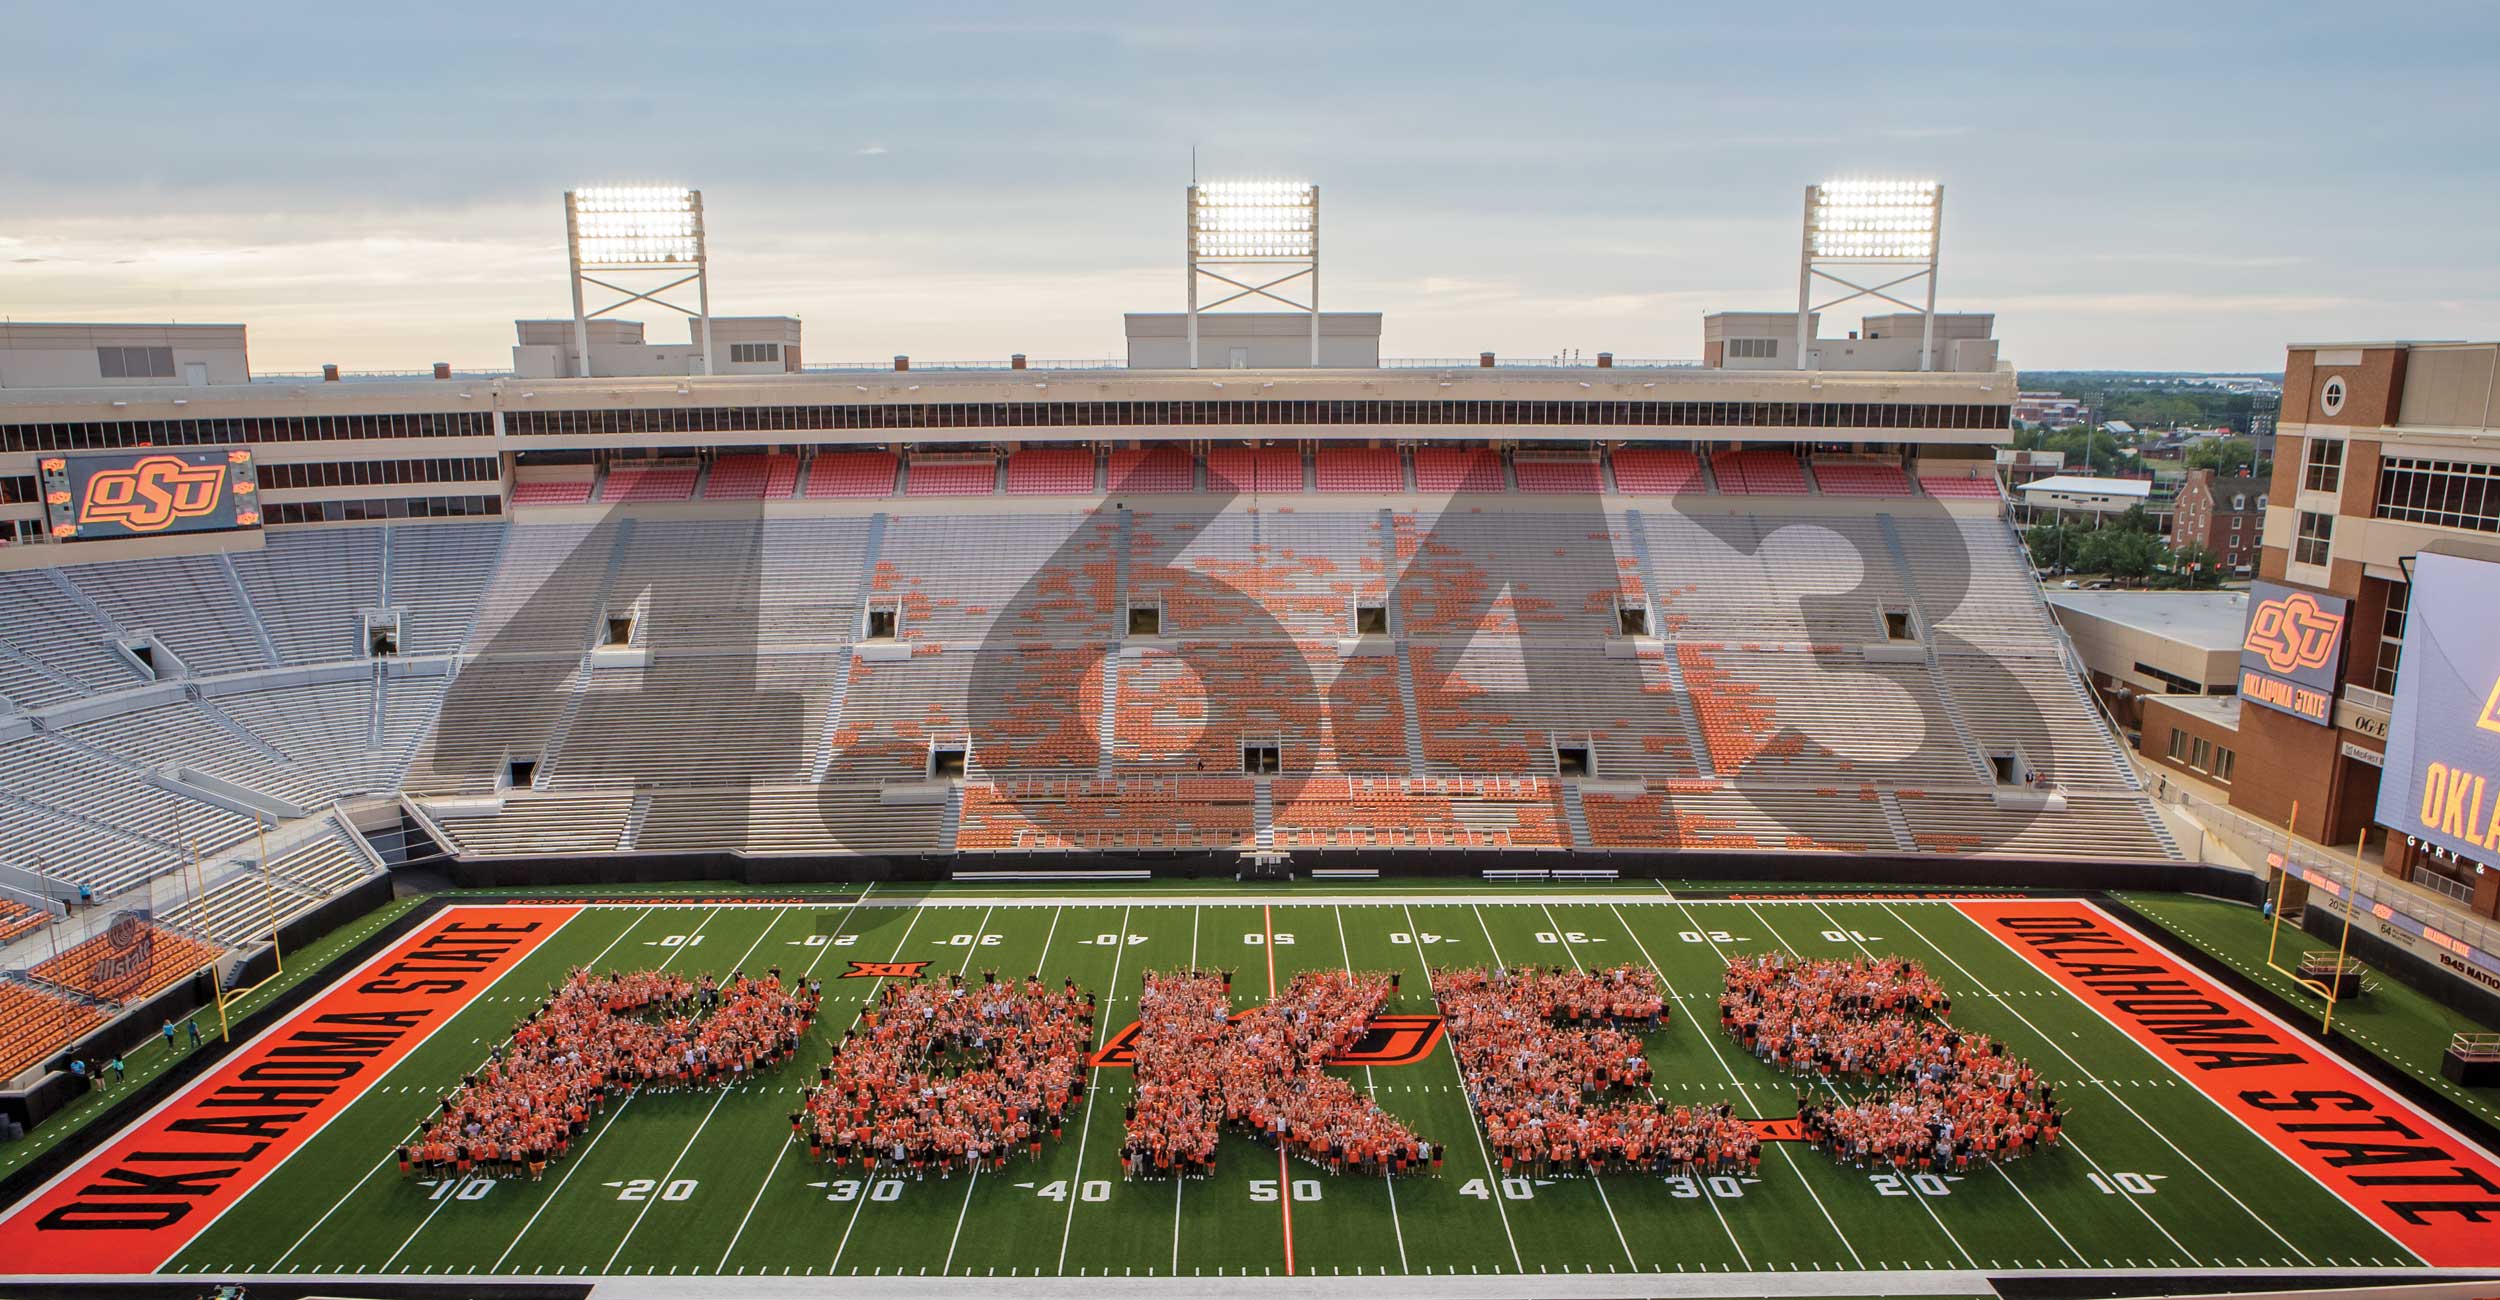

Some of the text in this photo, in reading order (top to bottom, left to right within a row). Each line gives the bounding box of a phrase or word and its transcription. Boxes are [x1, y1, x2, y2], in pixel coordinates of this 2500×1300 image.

[79, 455, 226, 531] OSU
[2243, 592, 2345, 674] OSU
[2243, 673, 2326, 718] OKLAHOMA STATE
[2407, 835, 2485, 875] GARY &
[2328, 898, 2339, 910] 20
[799, 934, 859, 946] 20
[950, 934, 1004, 946] 30
[1095, 934, 1149, 946] 40
[1244, 933, 1295, 946] 50
[1390, 932, 1442, 945] 40
[1535, 932, 1588, 944] 30
[1678, 931, 1734, 943] 20
[1821, 930, 1869, 942] 10
[2381, 924, 2391, 936] 64
[659, 935, 705, 947] 10
[92, 938, 151, 982] Allstate
[2440, 953, 2465, 973] 1945
[35, 921, 543, 1231] OKLAHOMA STATE
[1996, 917, 2500, 1225] OKLAHOMA STATE
[429, 1180, 497, 1200] 10
[617, 1180, 700, 1201] 20
[827, 1181, 905, 1201] 30
[1036, 1180, 1112, 1201] 40
[1249, 1180, 1323, 1202] 50
[1459, 1178, 1535, 1200] 40
[1664, 1176, 1744, 1198] 30
[1868, 1174, 1952, 1196] 20
[2086, 1172, 2158, 1195] 10
